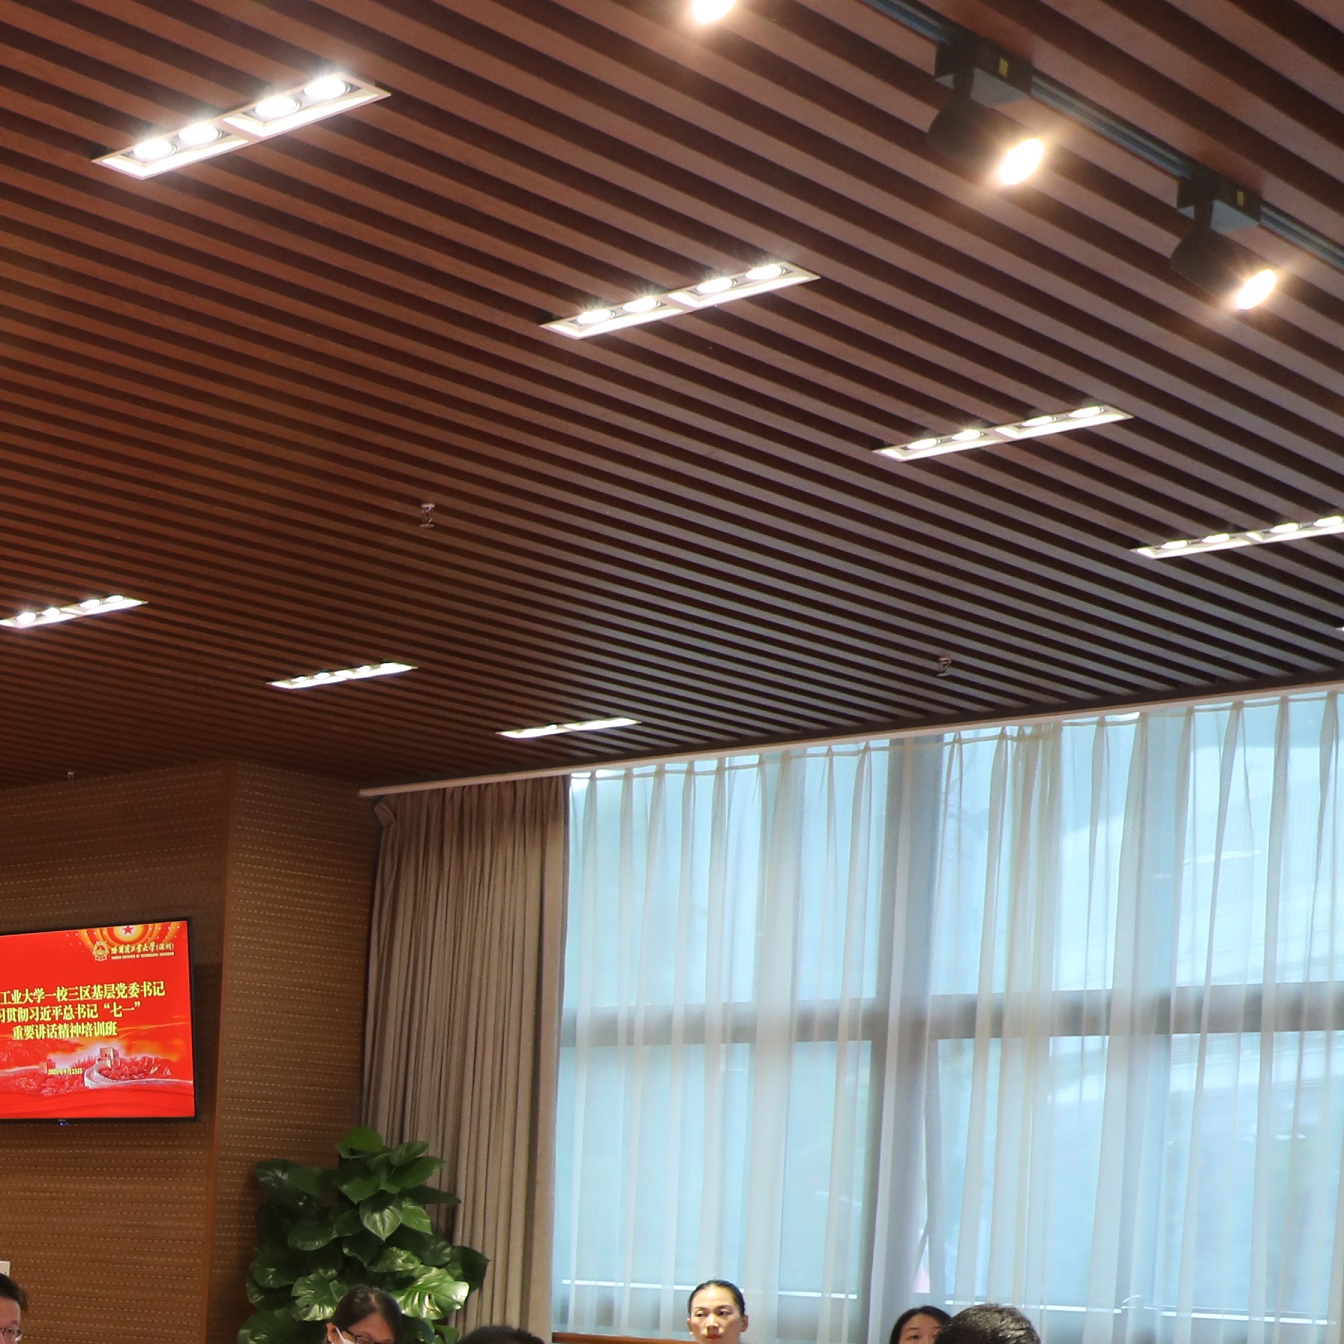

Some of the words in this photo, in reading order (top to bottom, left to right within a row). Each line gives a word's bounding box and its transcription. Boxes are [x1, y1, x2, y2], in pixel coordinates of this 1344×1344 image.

[12, 1021, 118, 1041] 重要讲话精神培训班
